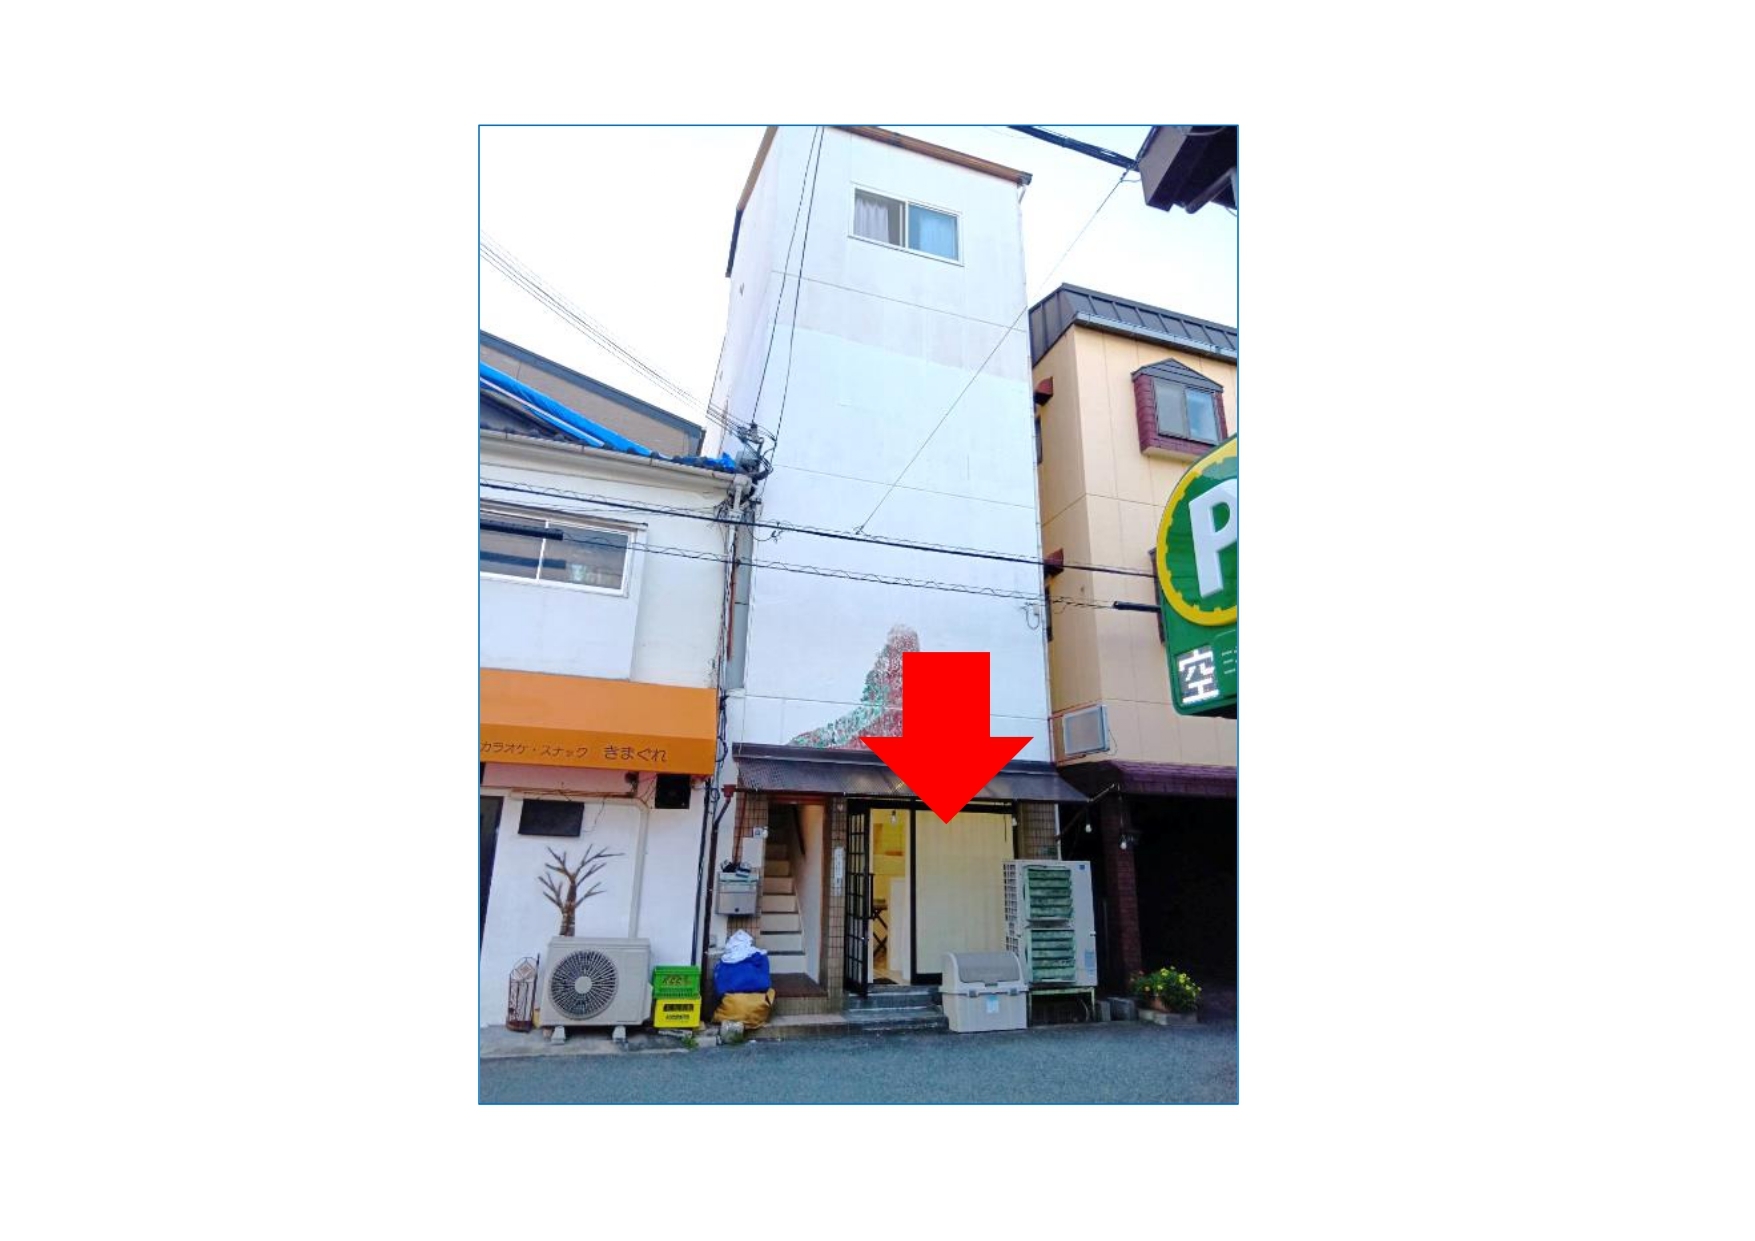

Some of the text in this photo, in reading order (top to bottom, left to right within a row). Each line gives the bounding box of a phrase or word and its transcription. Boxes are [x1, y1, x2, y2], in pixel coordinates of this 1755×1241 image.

[1188, 478, 1238, 599] P
[1178, 649, 1219, 703] 空
[480, 741, 668, 763] カラオケ・スナック きまぐれ
